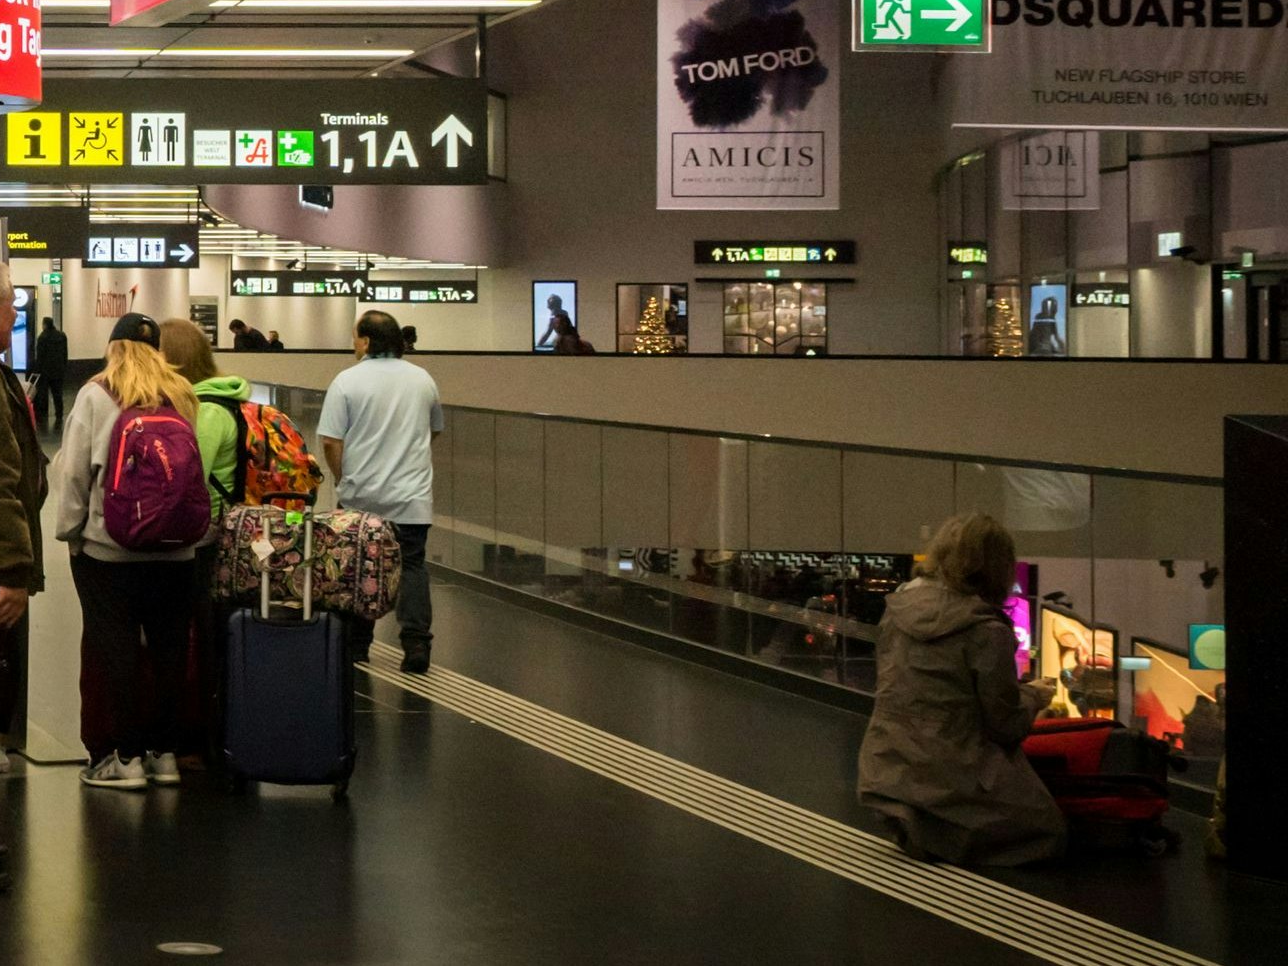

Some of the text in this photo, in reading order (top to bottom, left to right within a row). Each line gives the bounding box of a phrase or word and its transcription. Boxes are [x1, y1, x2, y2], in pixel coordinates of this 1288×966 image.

[682, 46, 816, 83] TOM FORD
[1055, 68, 1247, 84] NEW FLAGSHIP STORE
[1032, 90, 1149, 105] TUCHLAUBEN
[1183, 93, 1220, 106] 1010
[1225, 93, 1269, 107] WIEN
[321, 113, 389, 125] Terminals
[320, 130, 420, 173] 1,1A
[682, 146, 814, 167] AMICIS
[7, 233, 29, 241] rport
